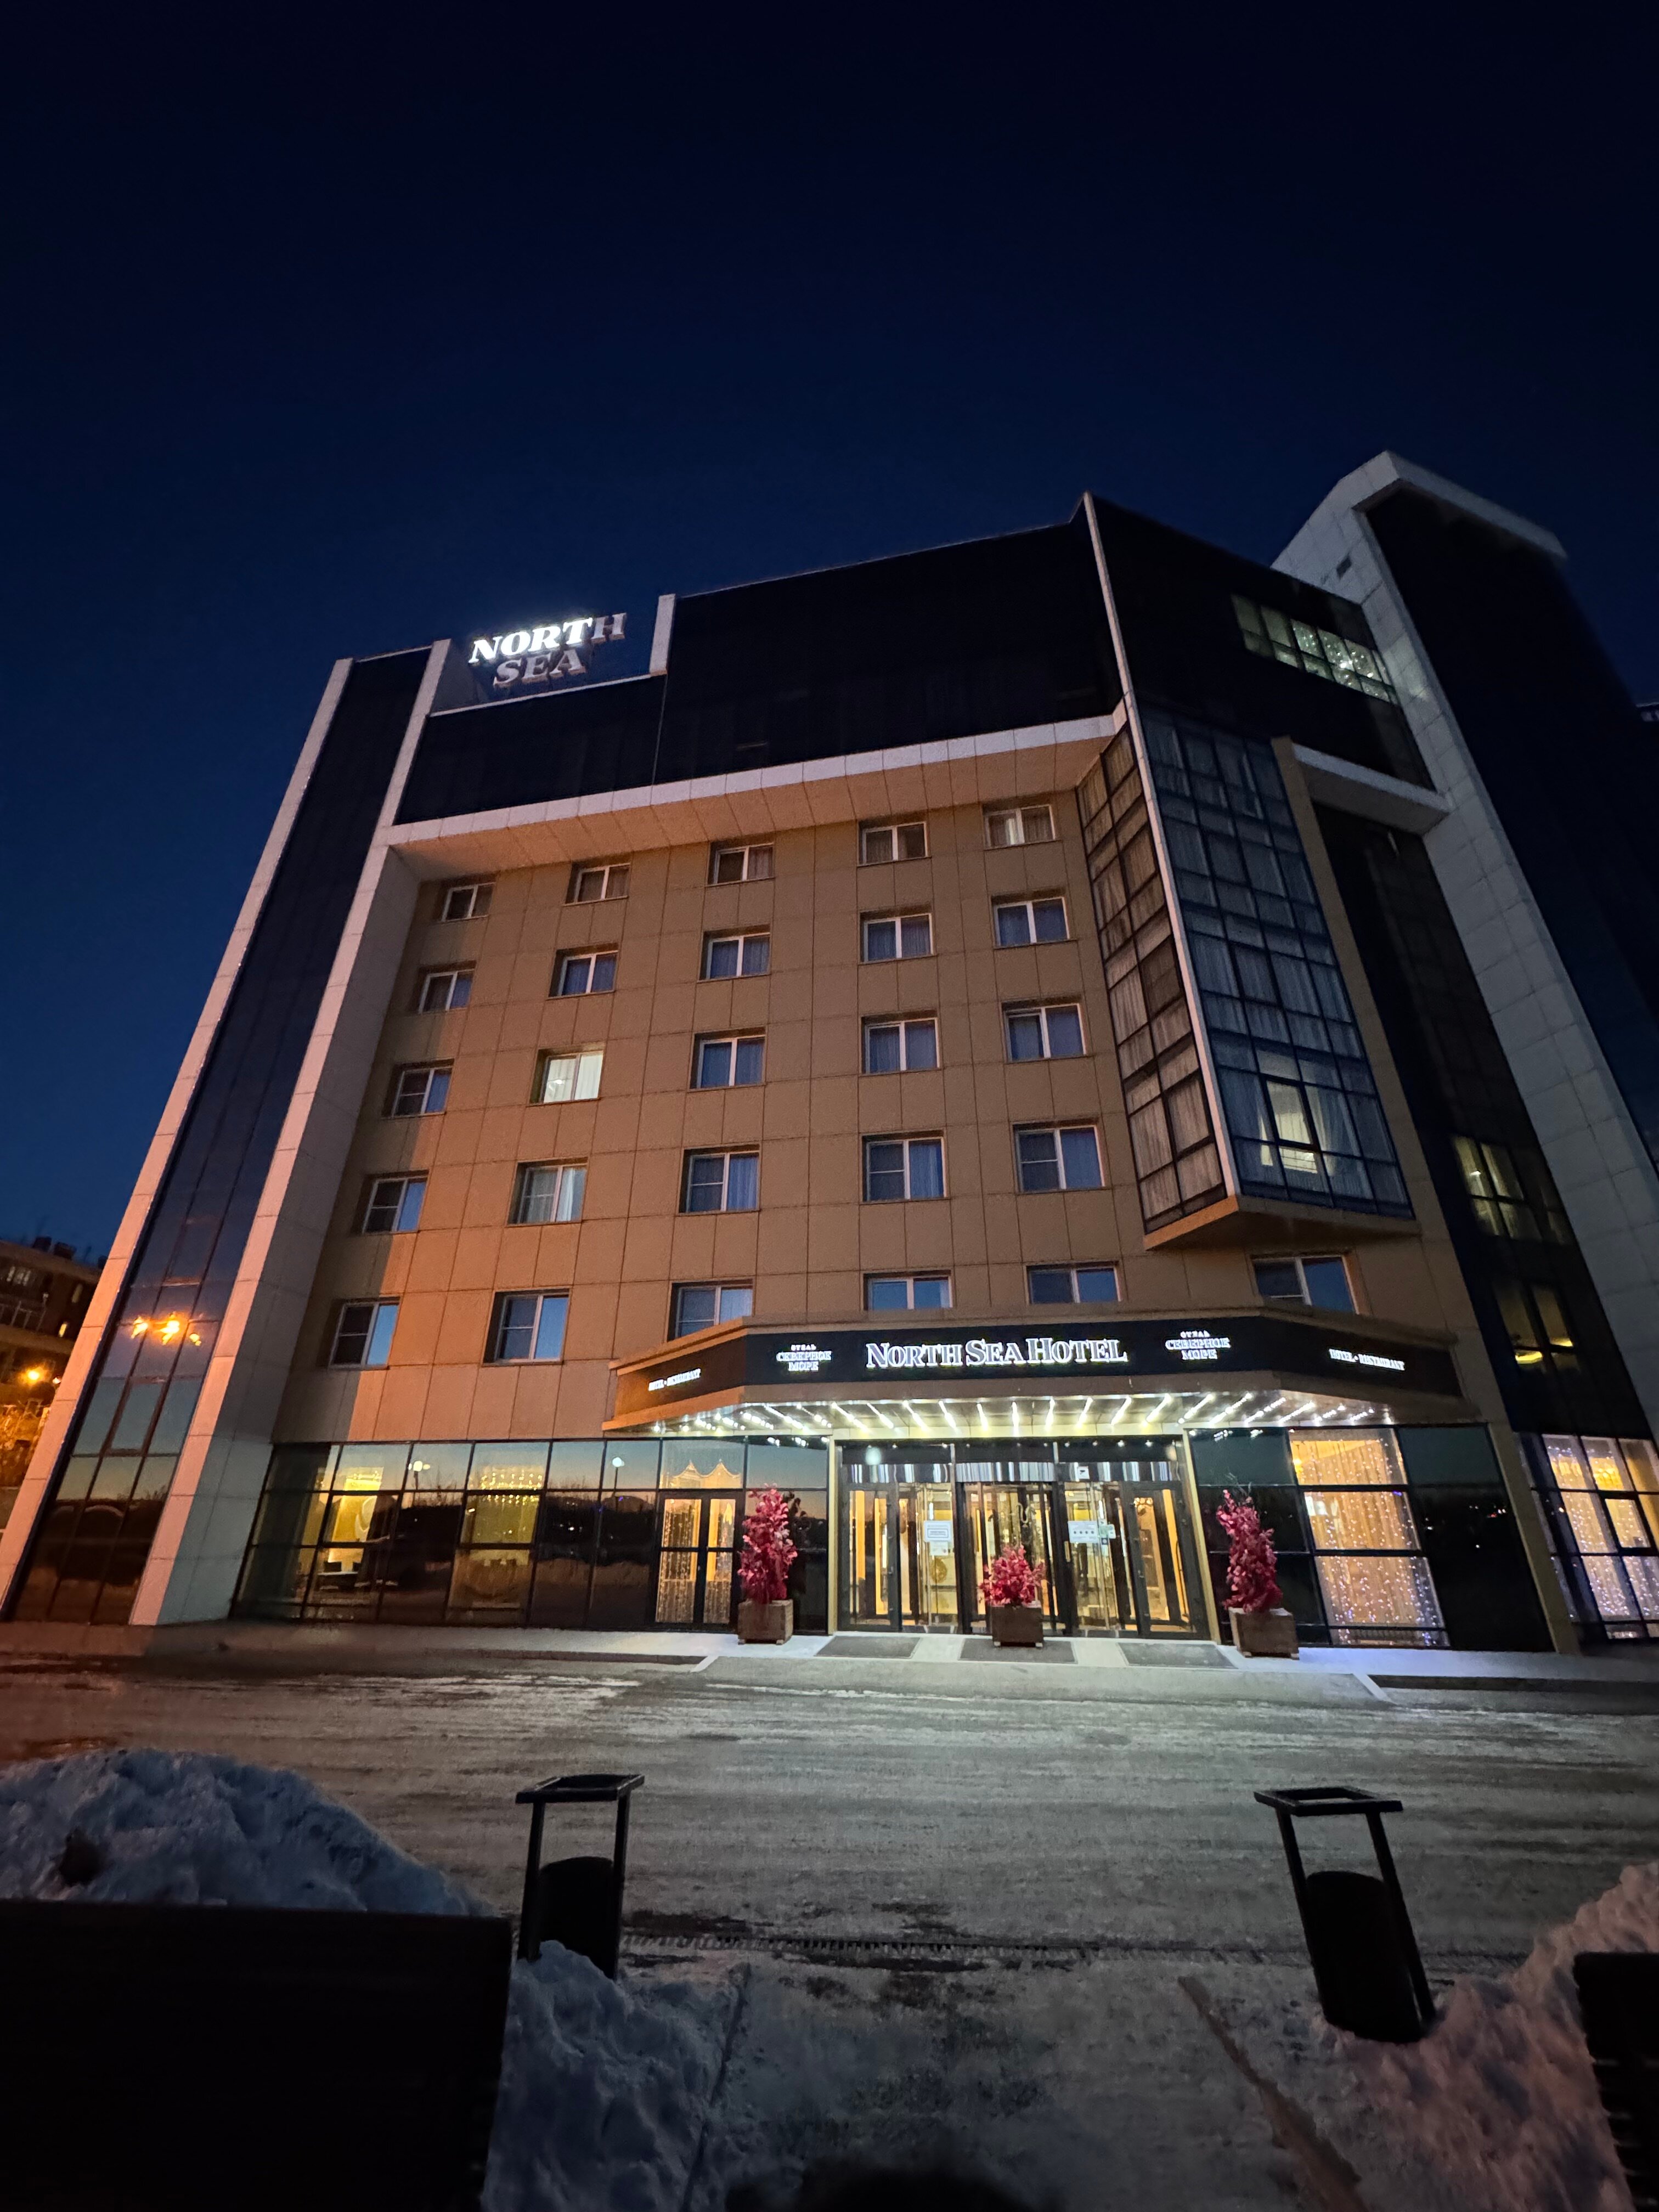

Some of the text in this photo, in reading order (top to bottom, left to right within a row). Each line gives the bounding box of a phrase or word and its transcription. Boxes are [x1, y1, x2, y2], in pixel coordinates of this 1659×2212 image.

[468, 612, 627, 664] NORTH
[493, 649, 585, 687] SEA
[788, 1361, 819, 1372] МОРЕ
[866, 1337, 1128, 1369] NORTH SEA HOTEL
